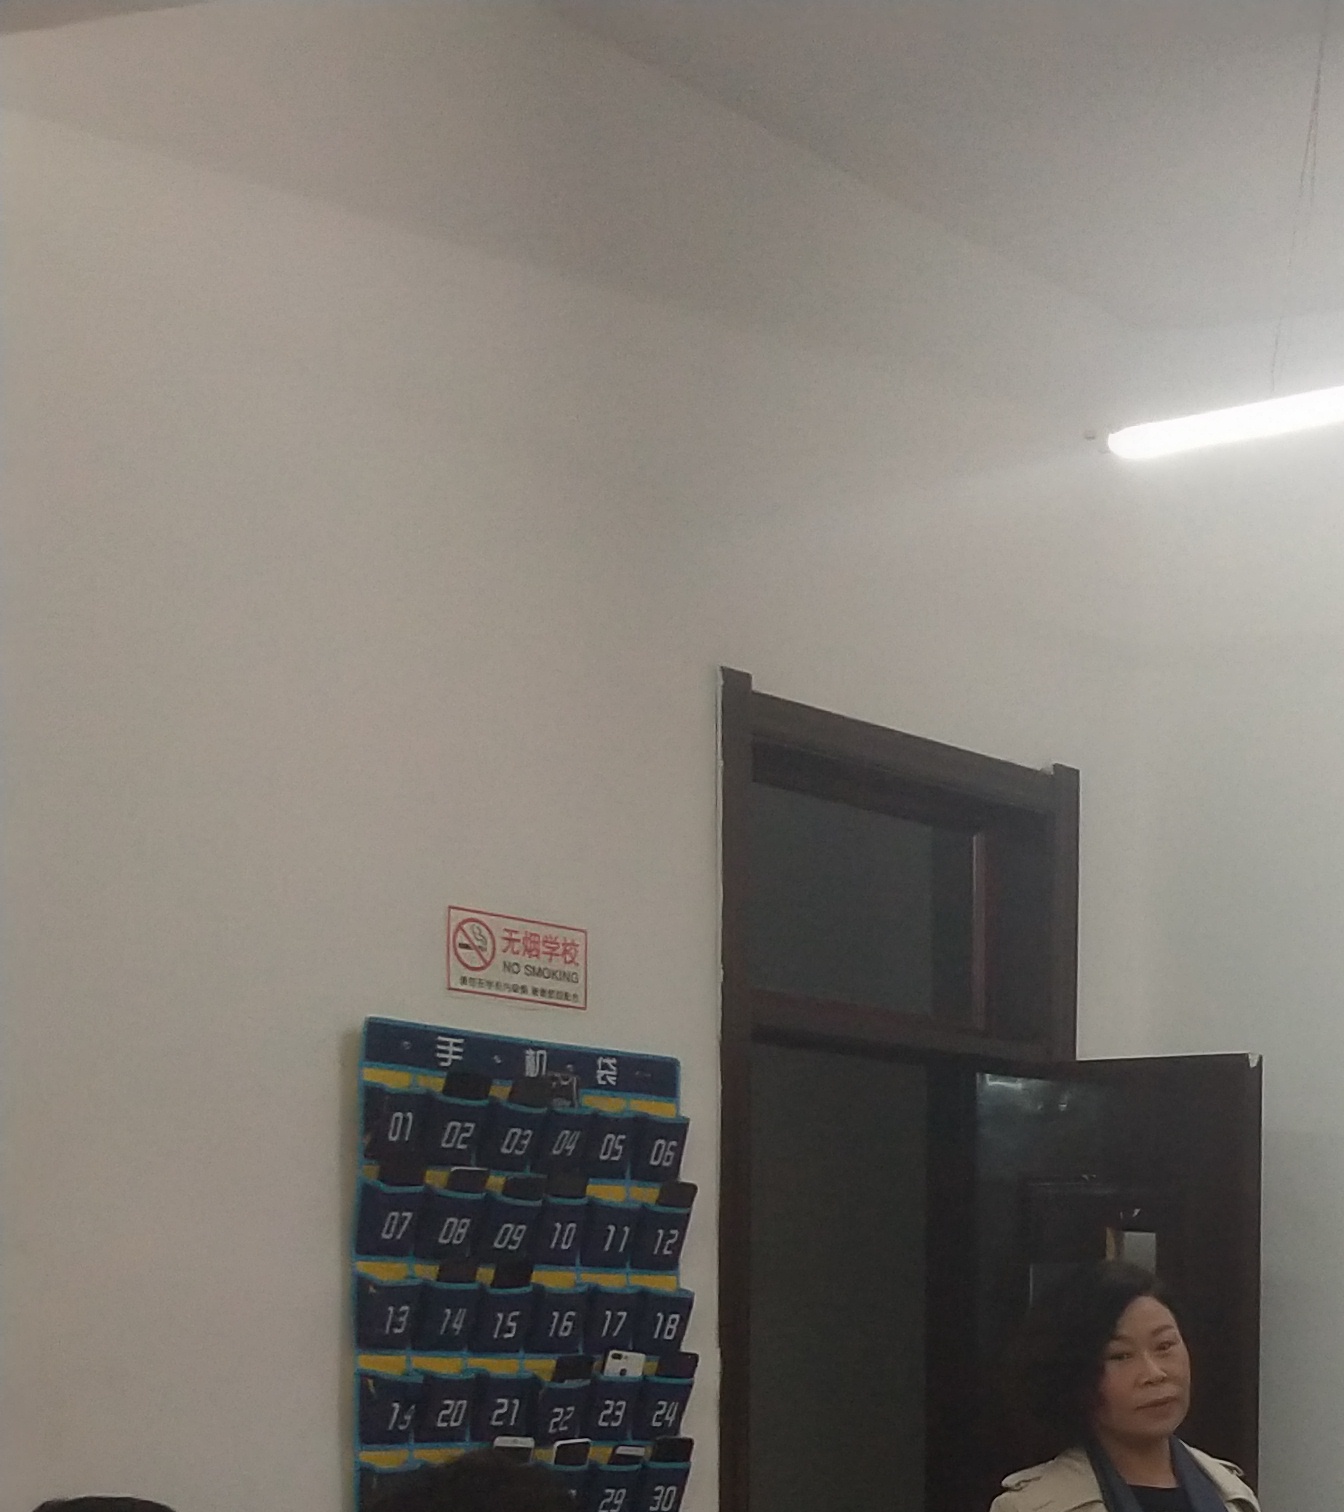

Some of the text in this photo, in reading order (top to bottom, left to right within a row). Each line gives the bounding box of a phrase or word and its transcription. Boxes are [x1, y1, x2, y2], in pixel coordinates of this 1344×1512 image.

[501, 928, 579, 965] 无烟学校
[503, 961, 579, 984] NO SMOKING
[388, 1112, 677, 1167] 01 02 03 04 05 06
[381, 1212, 679, 1255] 07 08 09 10 11 12
[385, 1306, 679, 1340] 13 14 15 16 17 18
[437, 1400, 467, 1427] 20
[490, 1399, 520, 1427] 21
[549, 1407, 575, 1433] 22
[598, 1401, 626, 1427] 23
[652, 1401, 678, 1427] 24
[649, 1486, 677, 1512] 30
